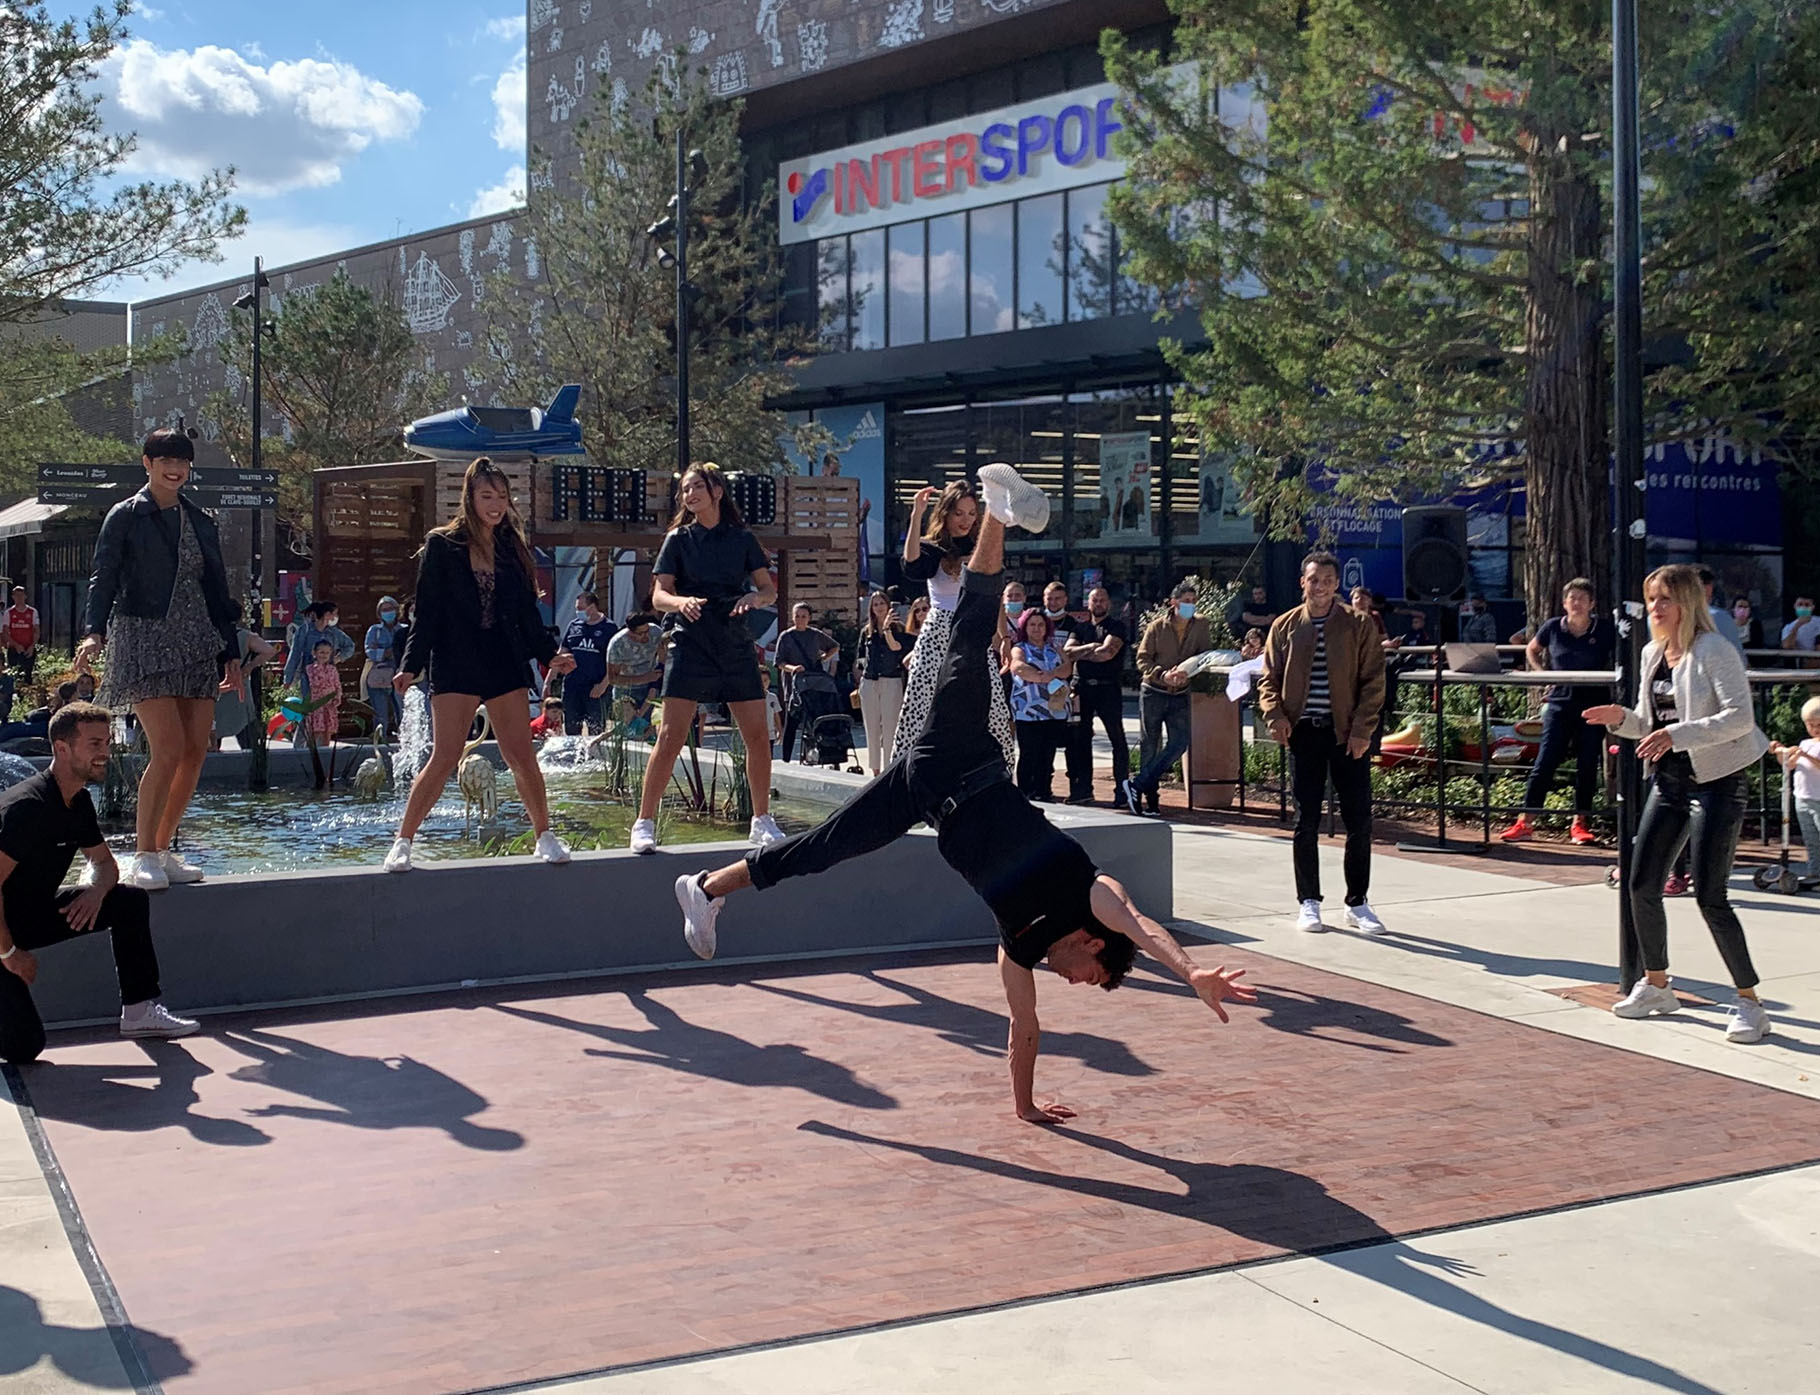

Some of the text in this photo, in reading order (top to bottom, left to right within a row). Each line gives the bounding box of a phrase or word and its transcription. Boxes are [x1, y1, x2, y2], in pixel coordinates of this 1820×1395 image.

[834, 98, 1124, 215] INTERSPO
[552, 465, 656, 522] FEEL
[1309, 506, 1401, 520] ERSONNASATION
[1337, 520, 1383, 533] FLOCAGE
